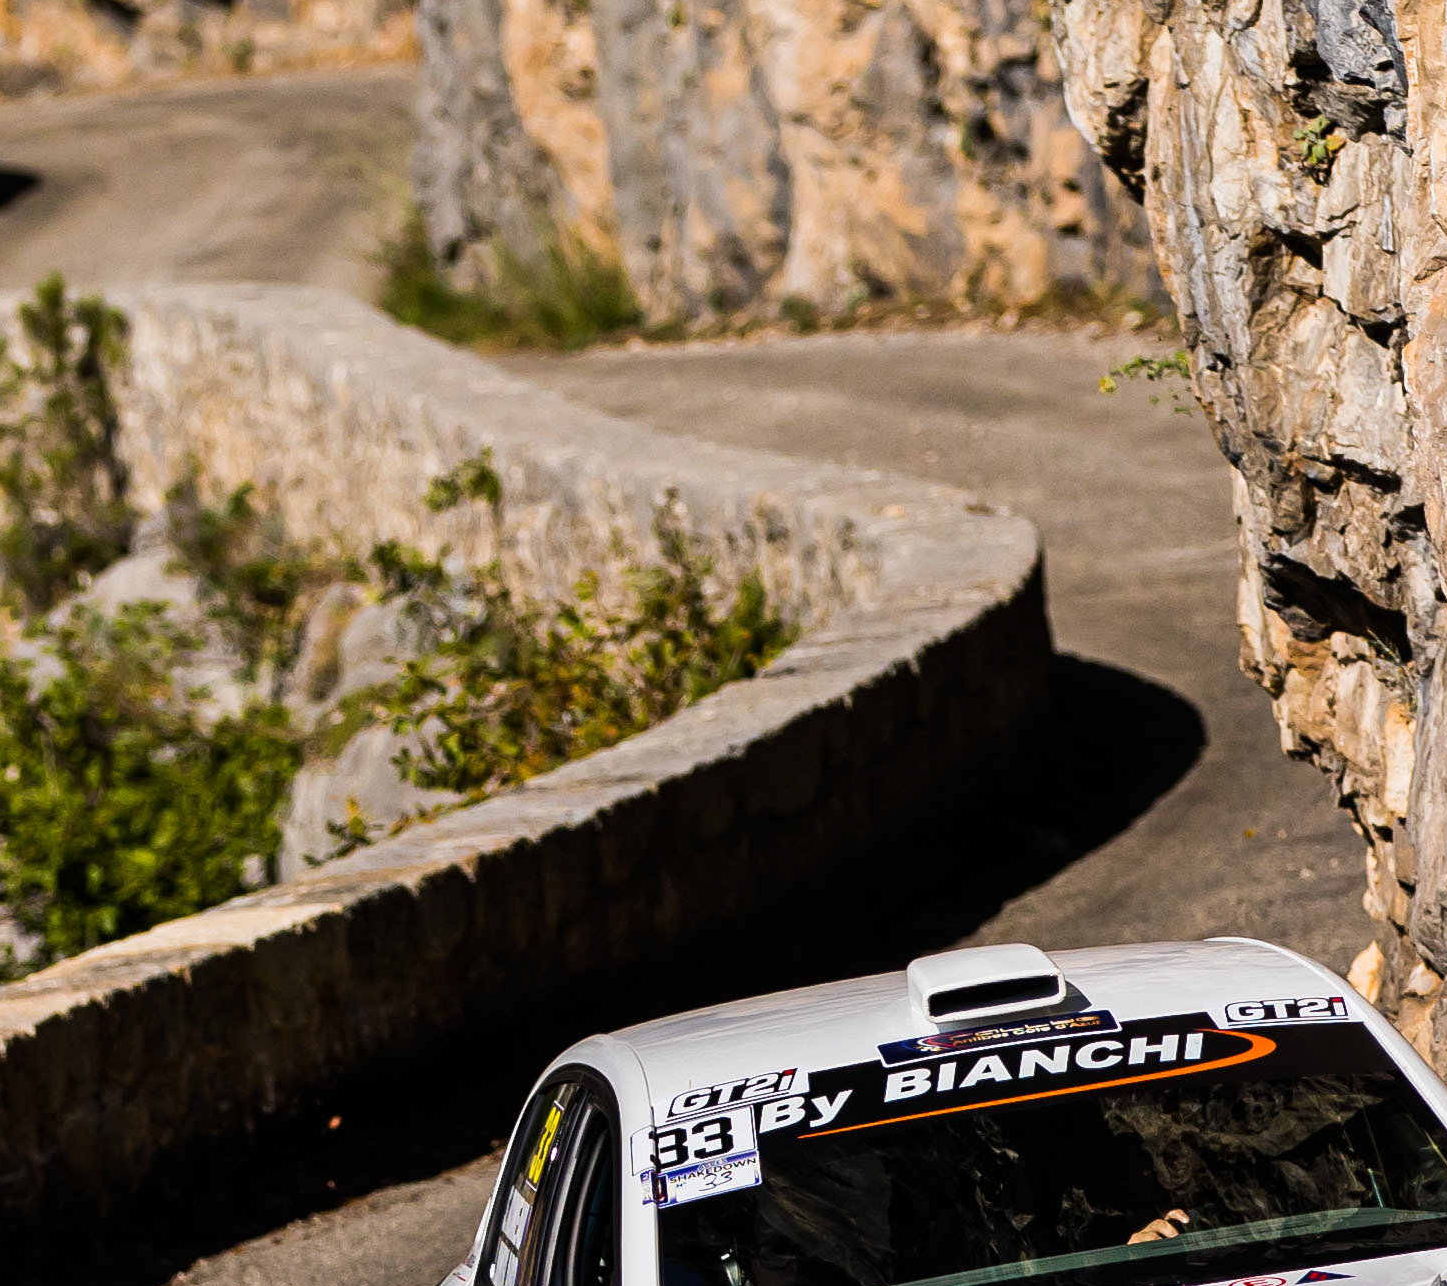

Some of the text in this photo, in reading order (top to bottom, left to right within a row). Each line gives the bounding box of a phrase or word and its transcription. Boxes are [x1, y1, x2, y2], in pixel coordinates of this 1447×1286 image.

[1225, 997, 1348, 1022] GT2i
[668, 1068, 797, 1116] GT2i
[759, 1032, 1205, 1133] By BIANCHI
[649, 1116, 734, 1173] 33
[669, 1158, 756, 1183] SHAKEDOWN
